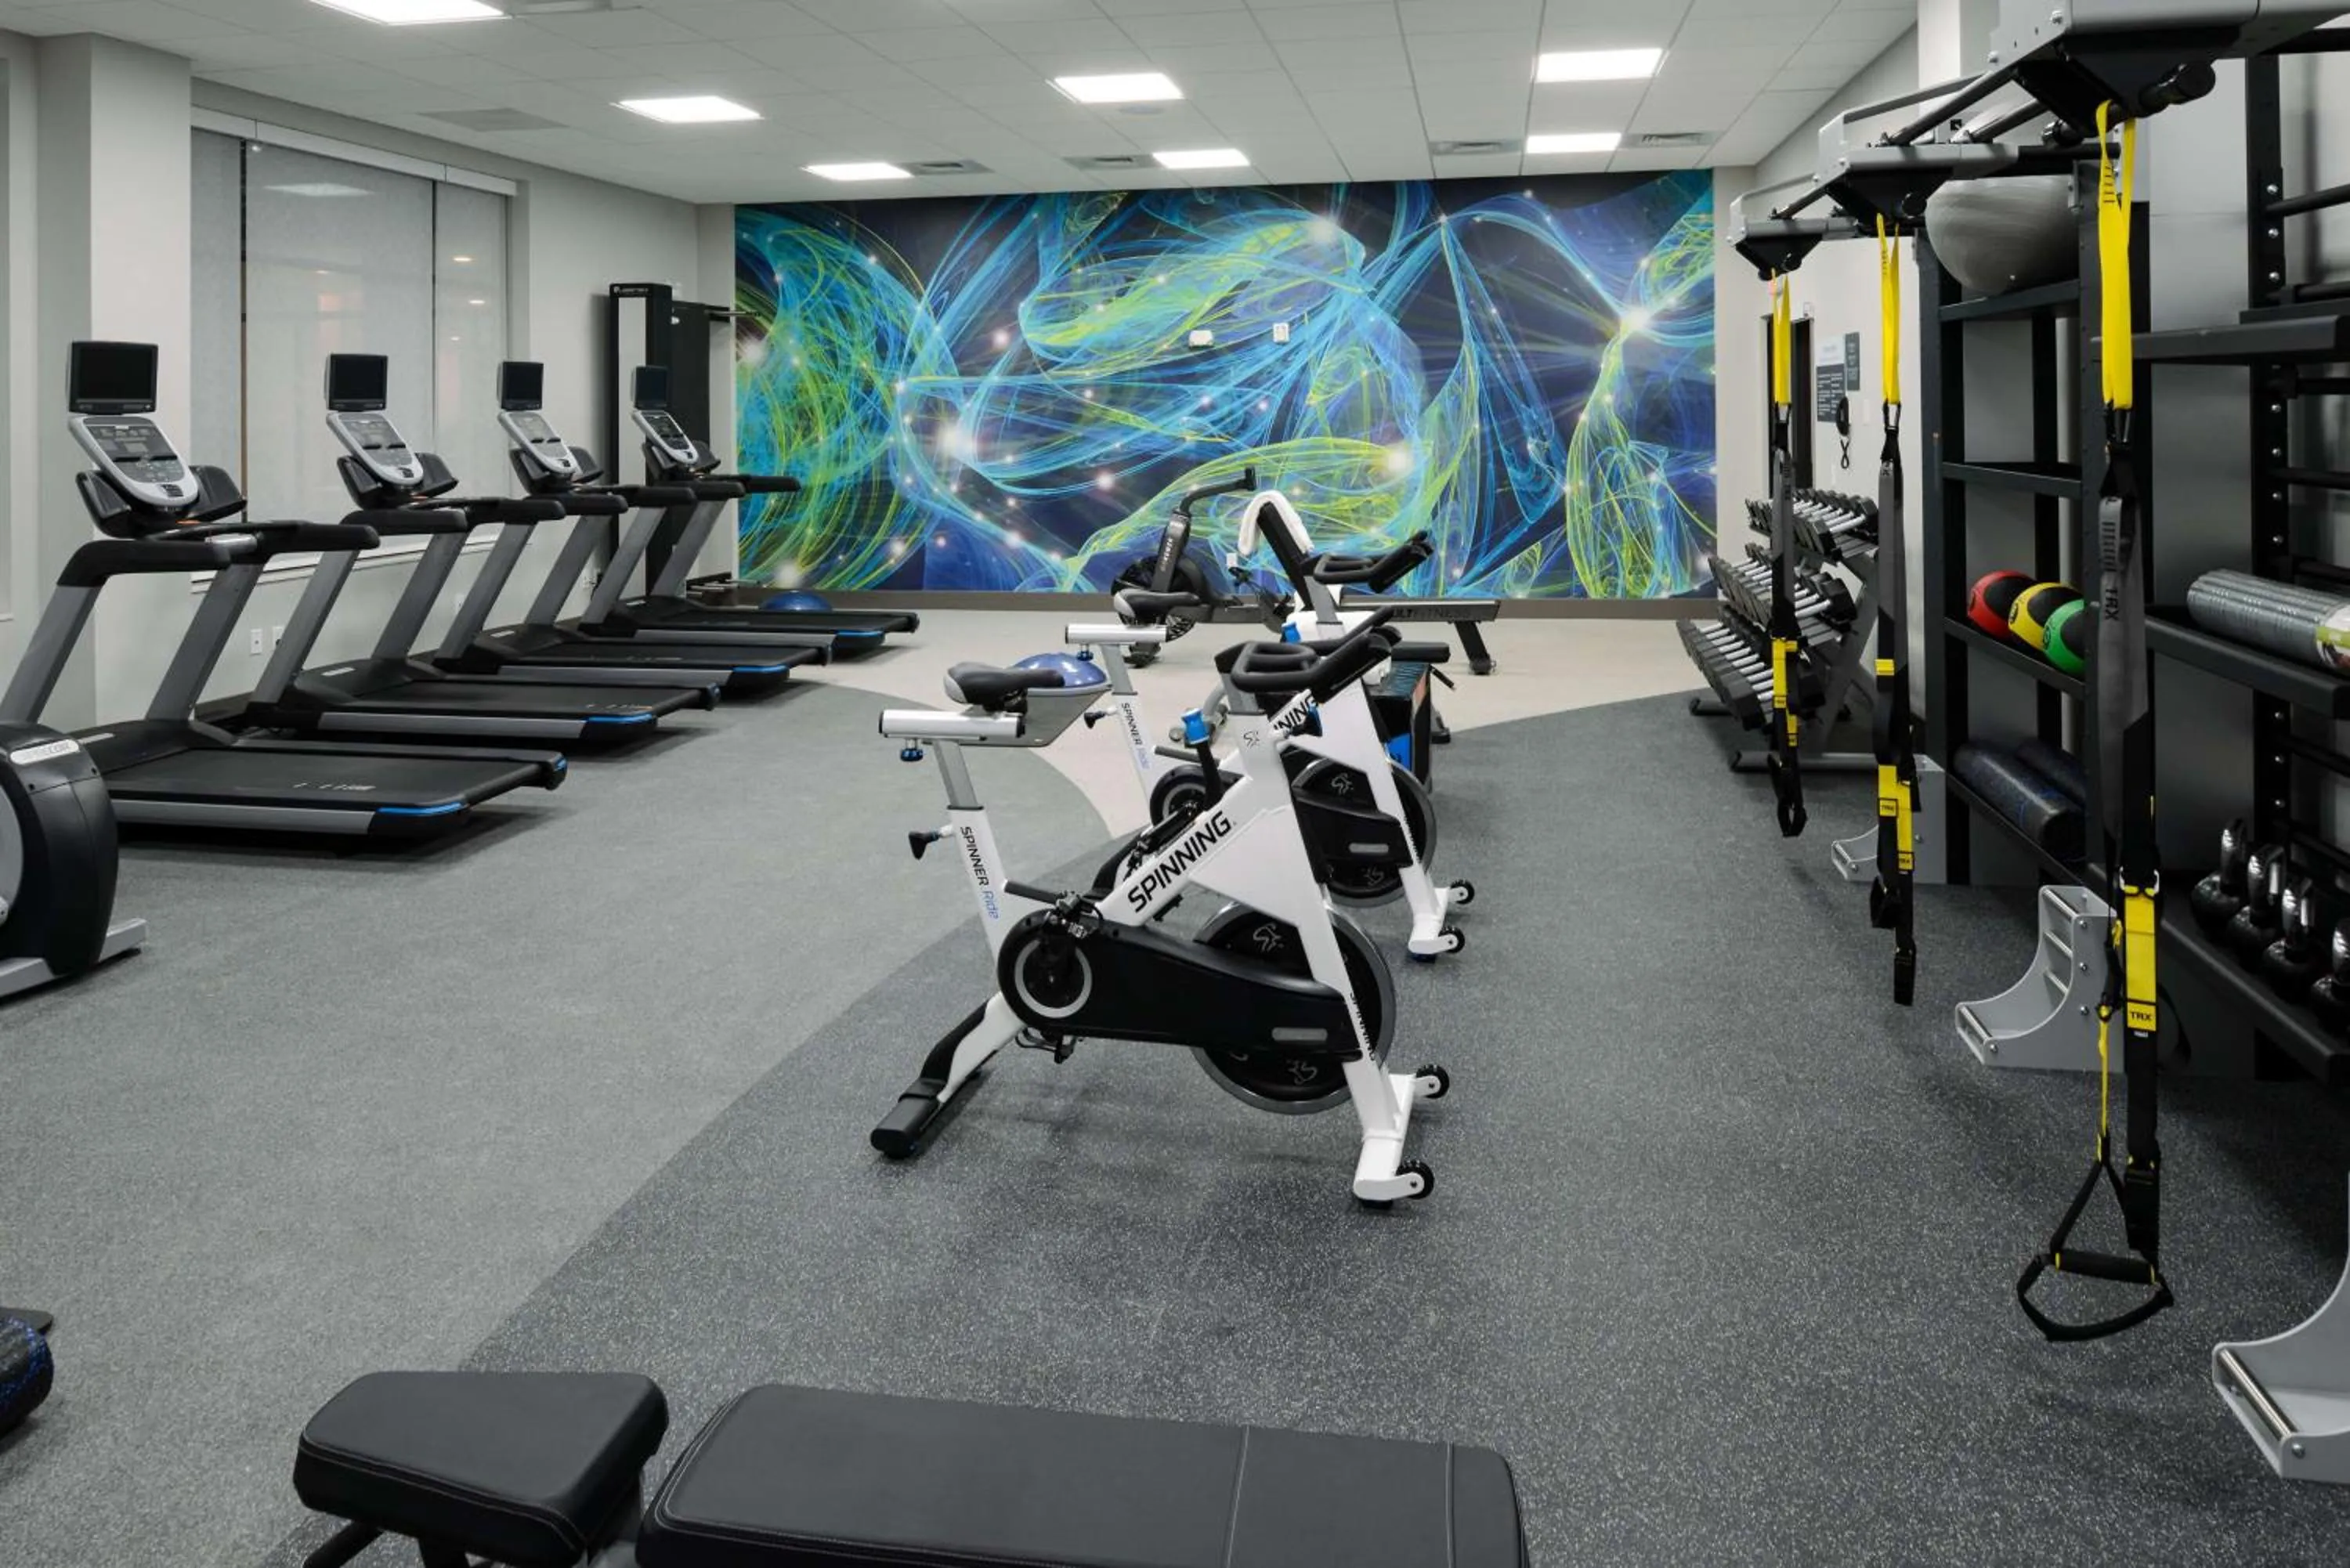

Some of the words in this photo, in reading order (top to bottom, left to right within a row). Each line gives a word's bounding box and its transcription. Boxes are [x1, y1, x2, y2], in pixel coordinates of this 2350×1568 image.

[2105, 589, 2119, 620] TRX
[1122, 703, 1142, 745] SPINNER
[960, 826, 989, 886] SPINNER
[982, 891, 999, 919] Ride
[1128, 810, 1231, 913] SPINNING
[2130, 1011, 2153, 1021] TRX
